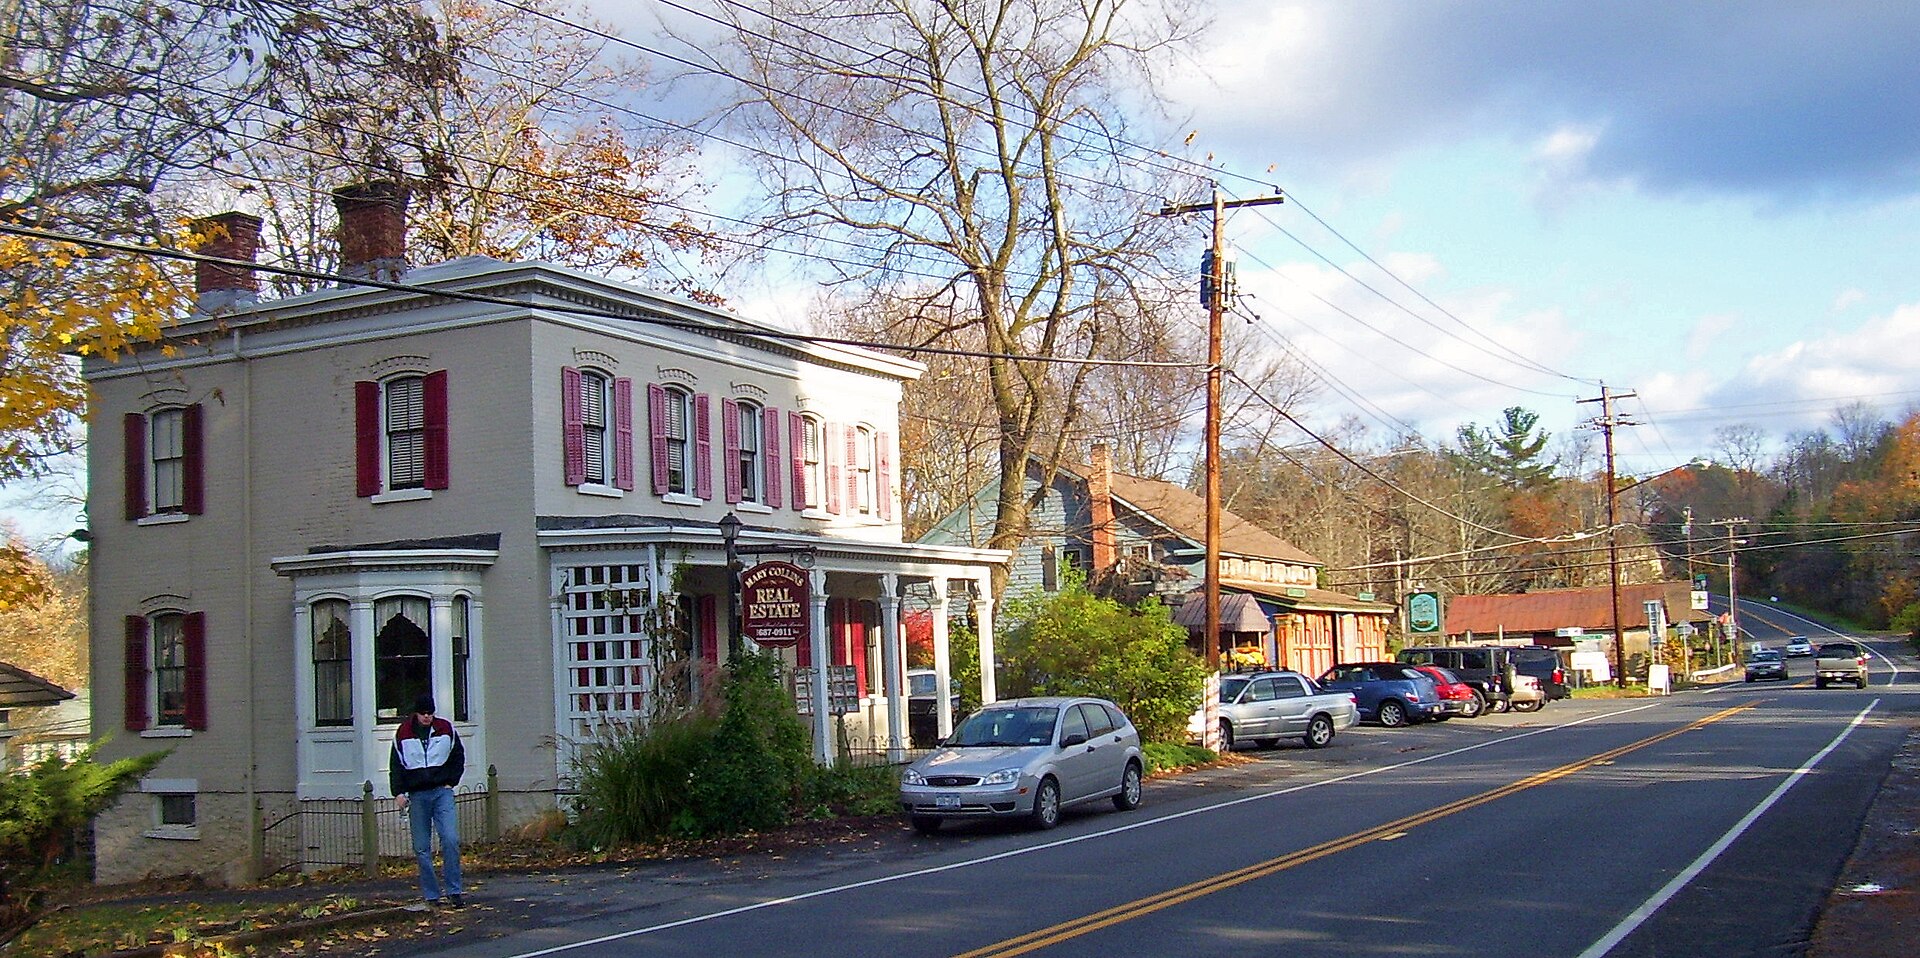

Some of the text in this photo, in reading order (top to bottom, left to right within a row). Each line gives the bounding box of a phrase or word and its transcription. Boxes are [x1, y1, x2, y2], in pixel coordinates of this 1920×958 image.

[745, 567, 804, 588] MARY COLLINS
[756, 588, 793, 603] REAL
[749, 603, 801, 618] ESTATE
